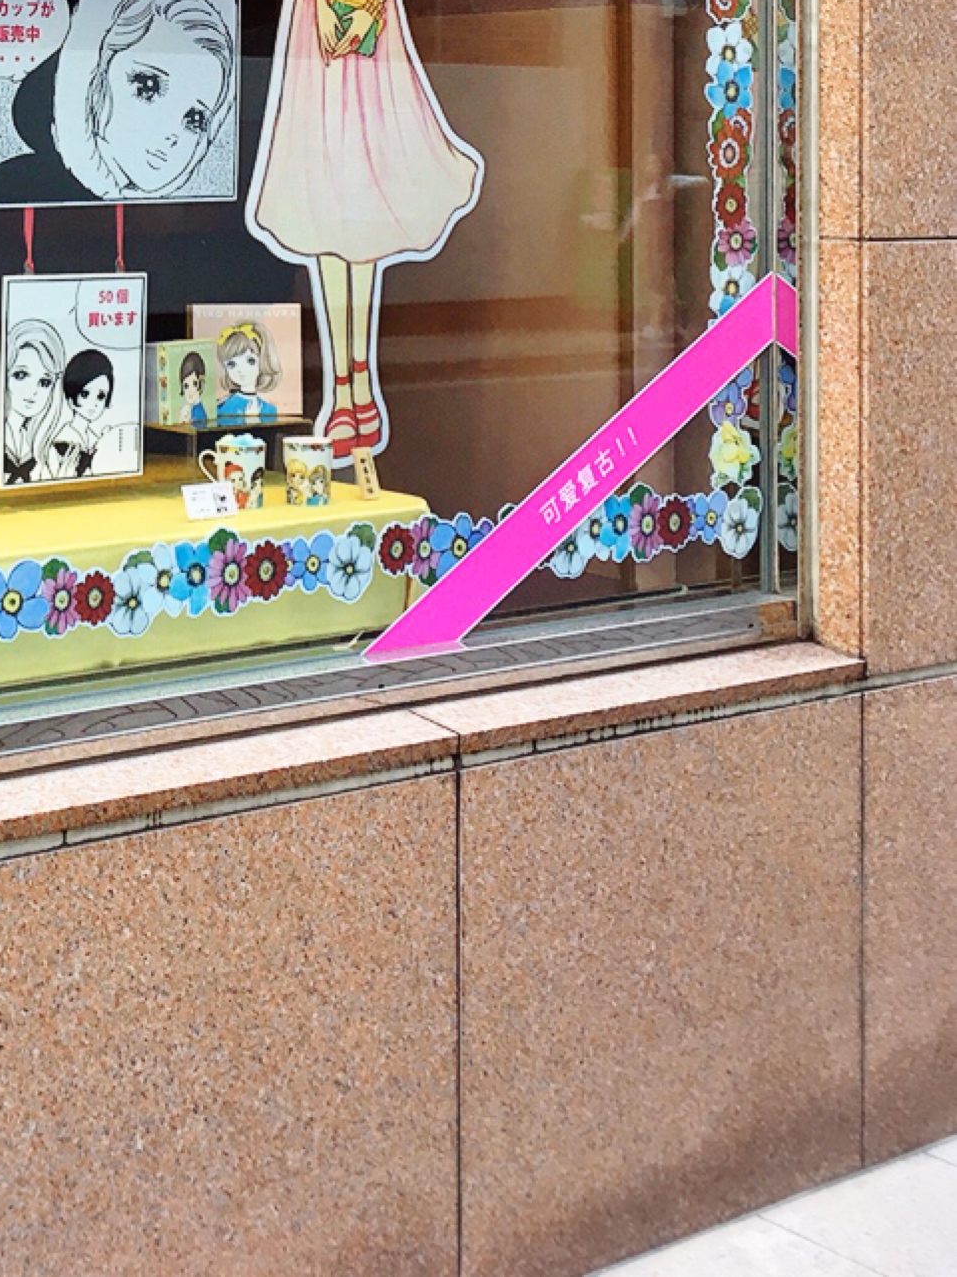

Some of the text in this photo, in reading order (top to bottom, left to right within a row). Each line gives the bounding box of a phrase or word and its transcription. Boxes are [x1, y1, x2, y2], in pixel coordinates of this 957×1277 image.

[98, 289, 129, 304] 50個
[88, 310, 137, 328] 買います
